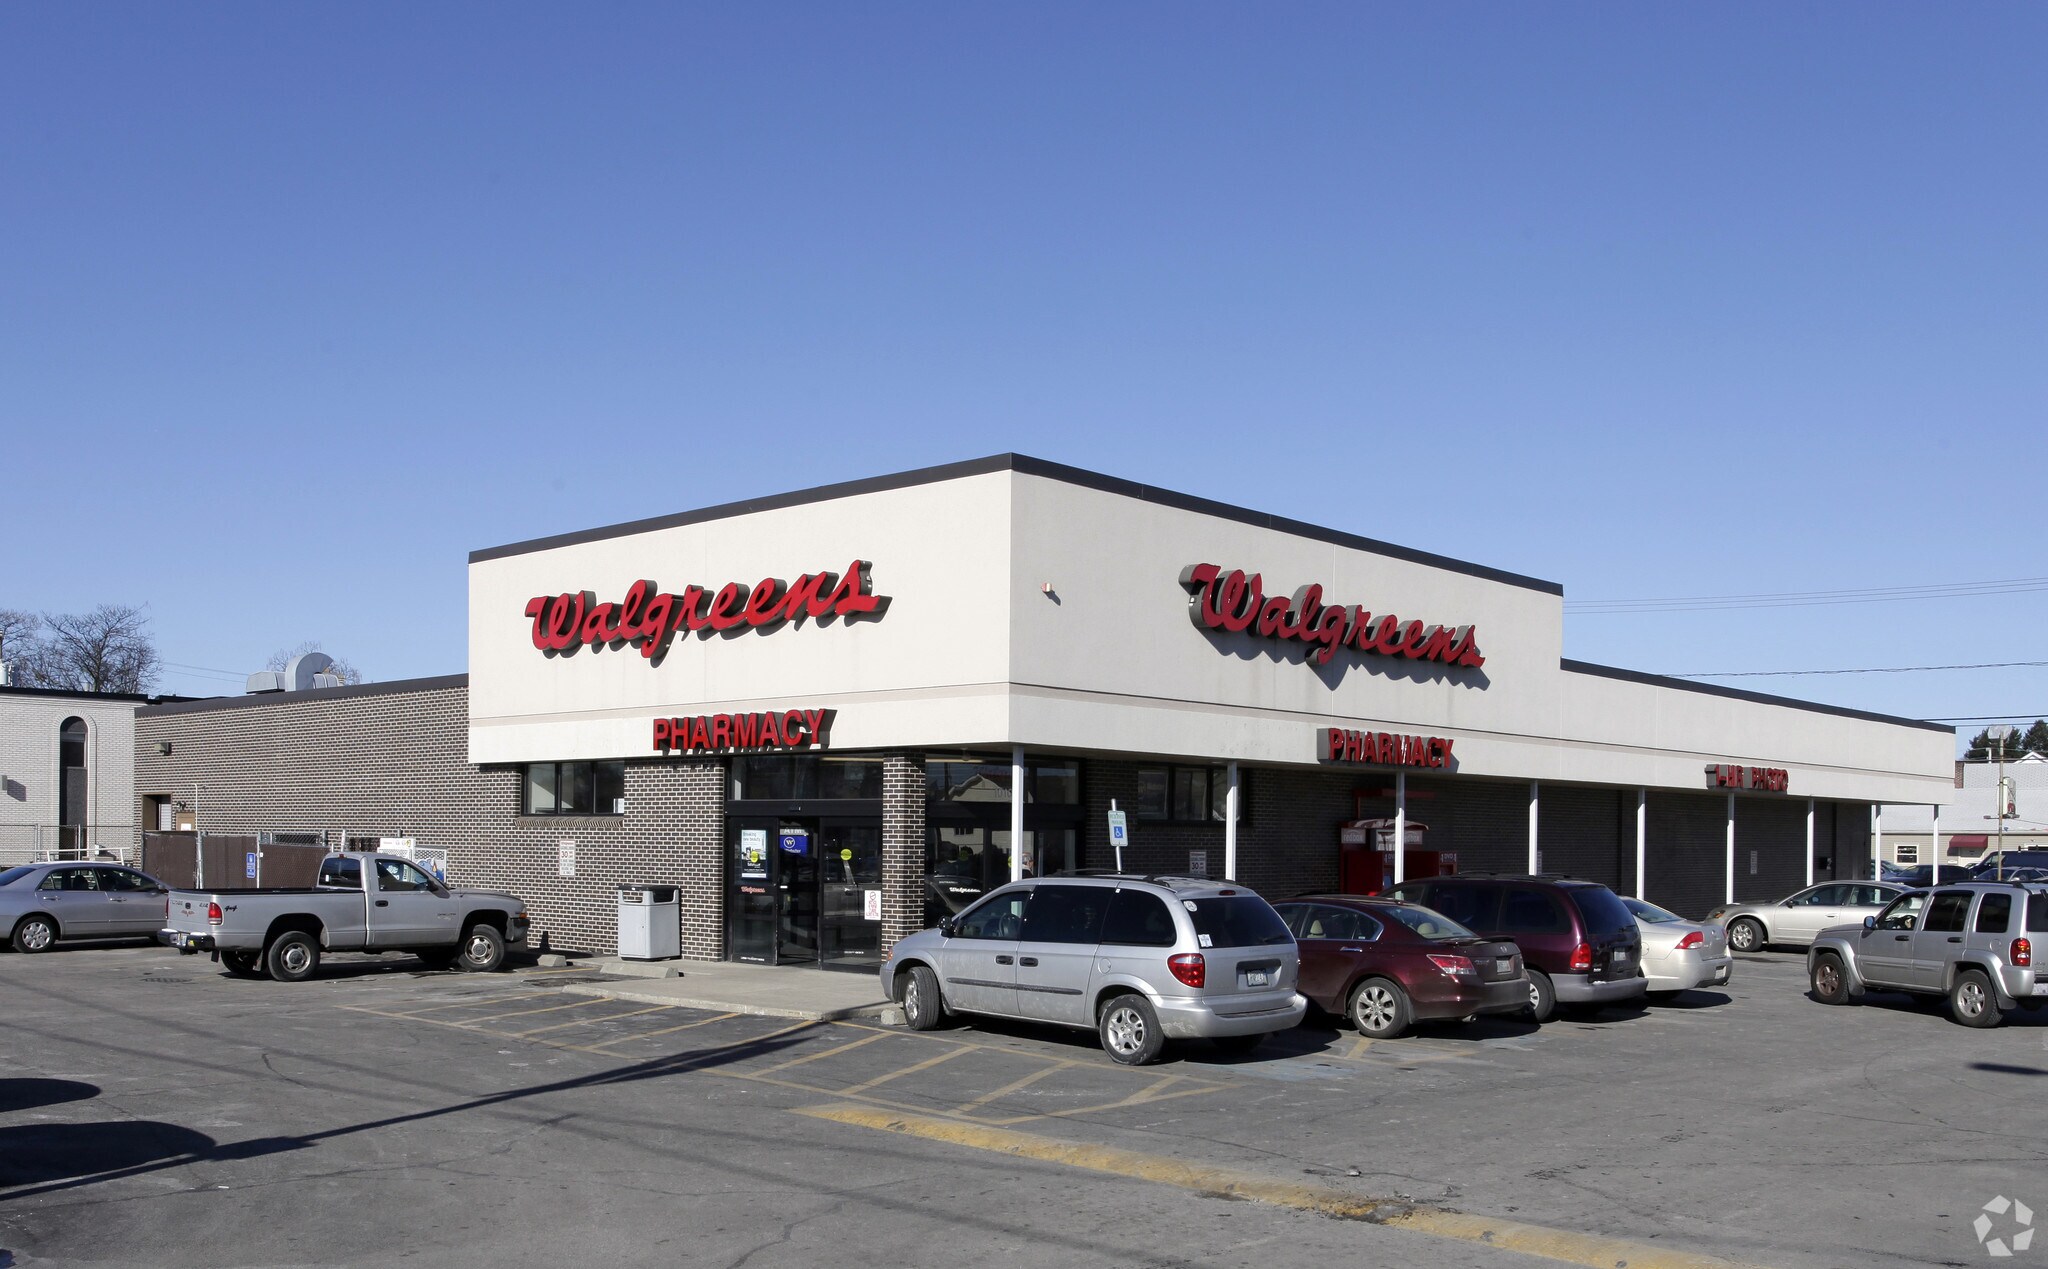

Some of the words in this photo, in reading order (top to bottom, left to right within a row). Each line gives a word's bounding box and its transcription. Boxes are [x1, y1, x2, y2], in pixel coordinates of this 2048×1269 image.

[525, 560, 884, 658] Walgreens
[1189, 562, 1486, 668] Walgreens
[653, 708, 826, 750] PHARMACY
[1328, 727, 1454, 768] PHARMACY
[1751, 767, 1789, 791] PHOTO
[561, 850, 569, 859] 30
[1191, 861, 1200, 870] 30
